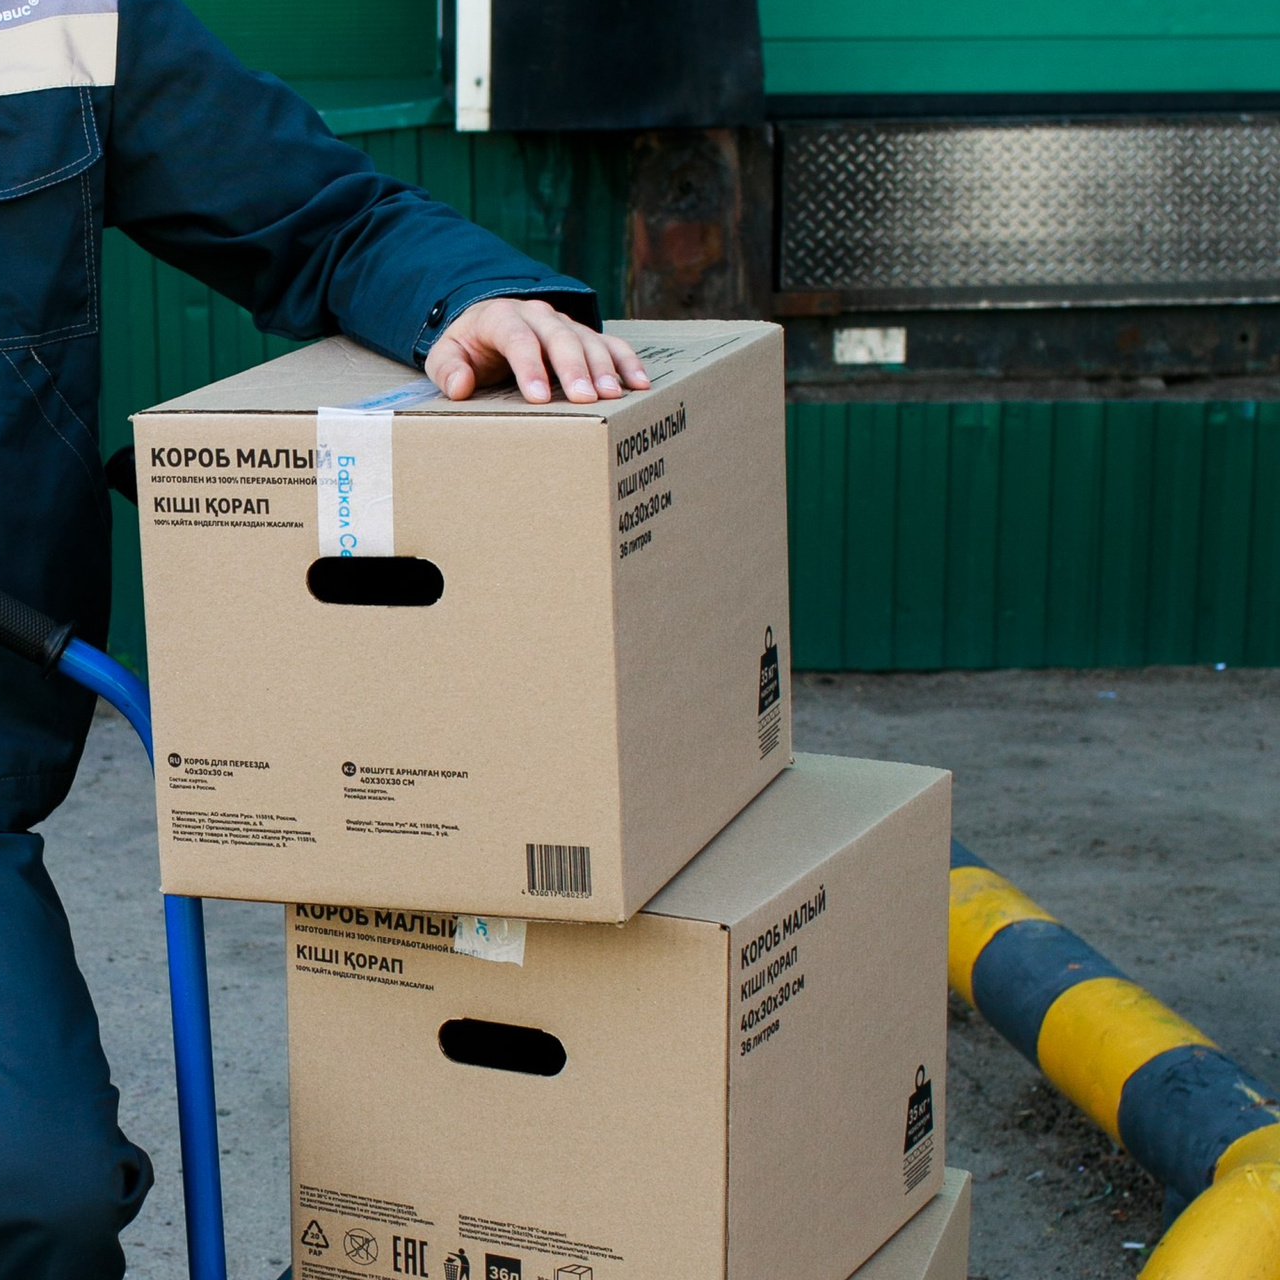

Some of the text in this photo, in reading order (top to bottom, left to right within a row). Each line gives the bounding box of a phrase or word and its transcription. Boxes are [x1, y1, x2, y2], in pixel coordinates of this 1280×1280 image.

[616, 401, 686, 466] КОРОБ МАЛЫЙ
[151, 448, 230, 468] КОРОБ
[150, 476, 204, 484] ИЗГОТОВЛЕН
[239, 477, 317, 485] ПЕРЕРАБОТАННОЙ
[638, 457, 665, 491] ҚОРАП
[338, 456, 355, 528] Байкал
[661, 490, 672, 511] см
[153, 497, 269, 516] КІШІ ҚОРАП
[170, 519, 192, 527] ҚАЙТА
[620, 530, 652, 559] 36 литров
[183, 758, 270, 770] КОРОБ ДЛЯ ПЕРЕЕЗДА
[440, 770, 468, 779] ҚОРАП
[295, 904, 369, 925] КОРОБ
[741, 884, 826, 969] КОРОБ МАЛЫЙ
[294, 924, 344, 938] ИЗГОТОВЛЕН
[345, 931, 355, 939] ИЗ
[356, 933, 375, 942] 100%
[376, 935, 448, 953] ПЕРЕРАБОТАННОЙ
[295, 965, 311, 973] 100%
[296, 945, 402, 973] КІШІ ҚОРАП
[767, 945, 798, 985] ҚОРАП
[792, 974, 804, 996] см
[740, 1019, 780, 1056] 36 литров
[310, 1232, 320, 1240] 20
